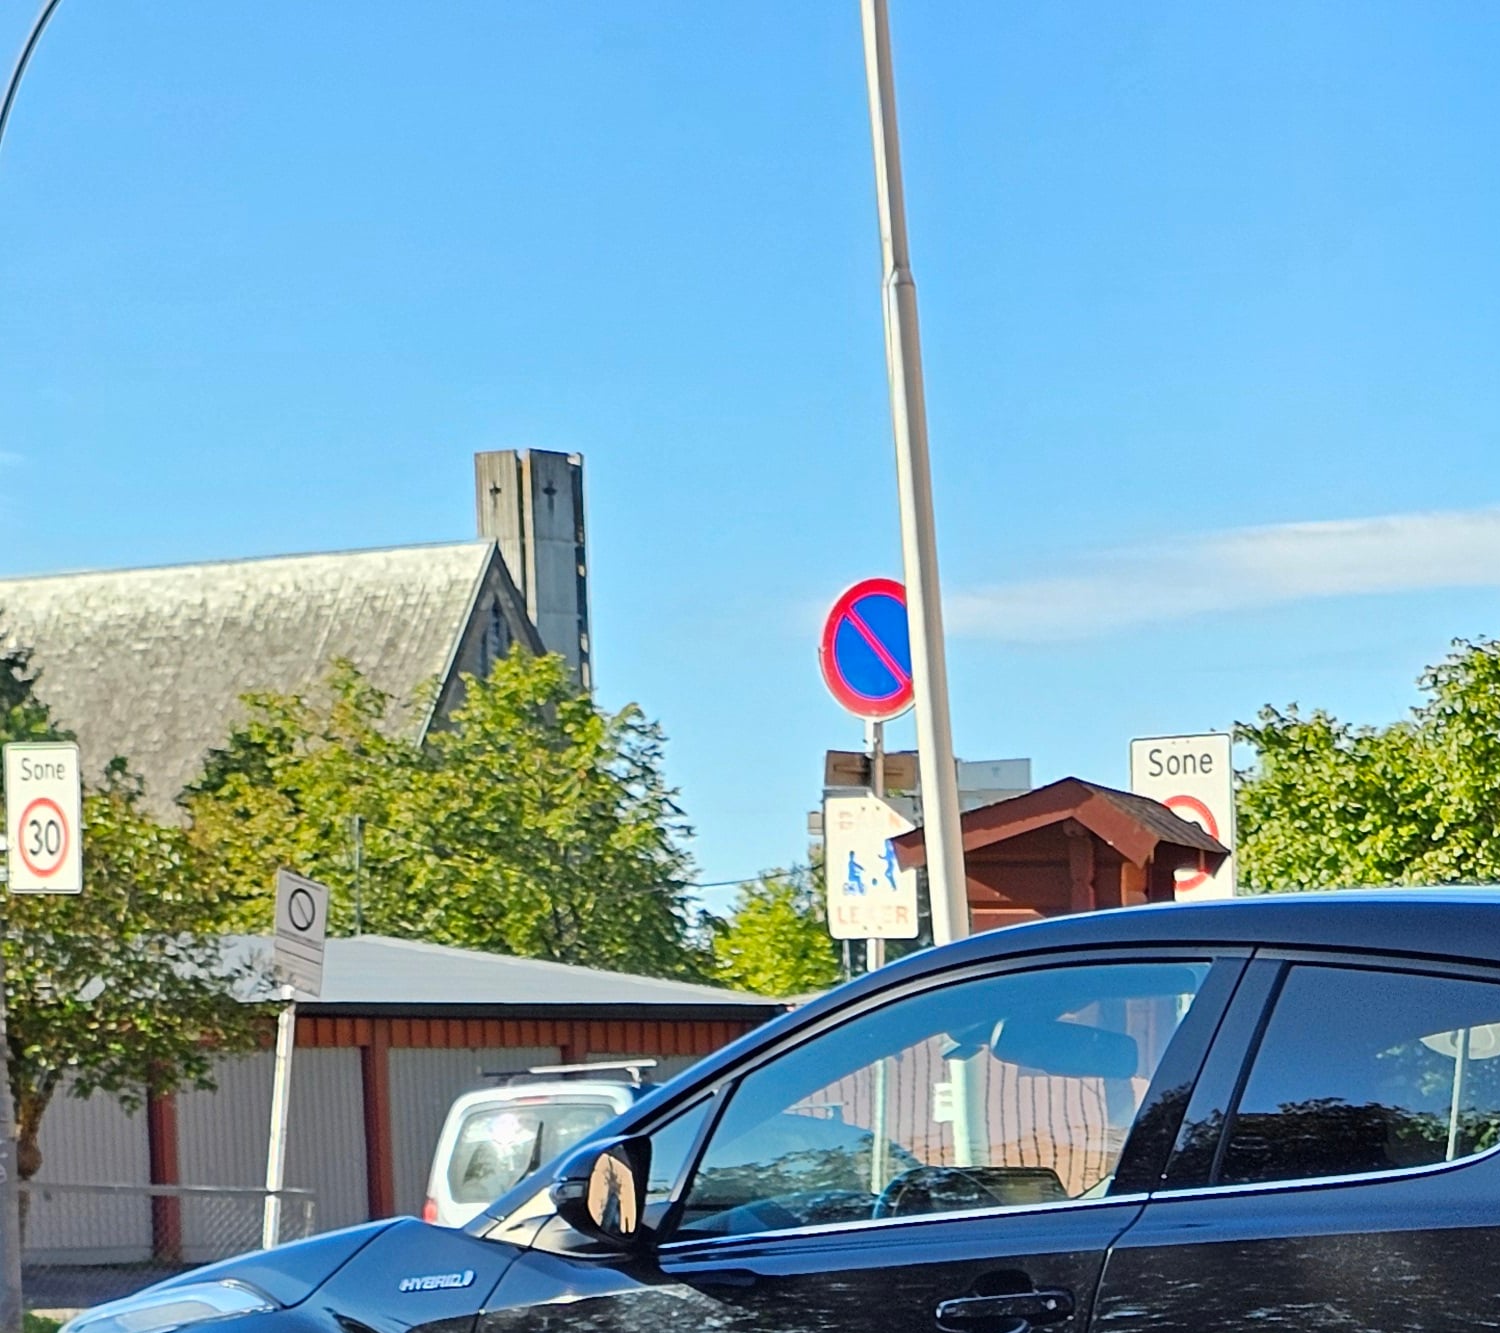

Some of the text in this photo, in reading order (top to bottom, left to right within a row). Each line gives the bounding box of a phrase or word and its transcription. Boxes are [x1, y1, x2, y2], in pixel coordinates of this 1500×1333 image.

[20, 757, 65, 781] Sone
[1148, 747, 1213, 778] Sone
[28, 819, 61, 856] 30
[836, 906, 909, 925] LEER
[399, 1273, 463, 1291] HYBRID
